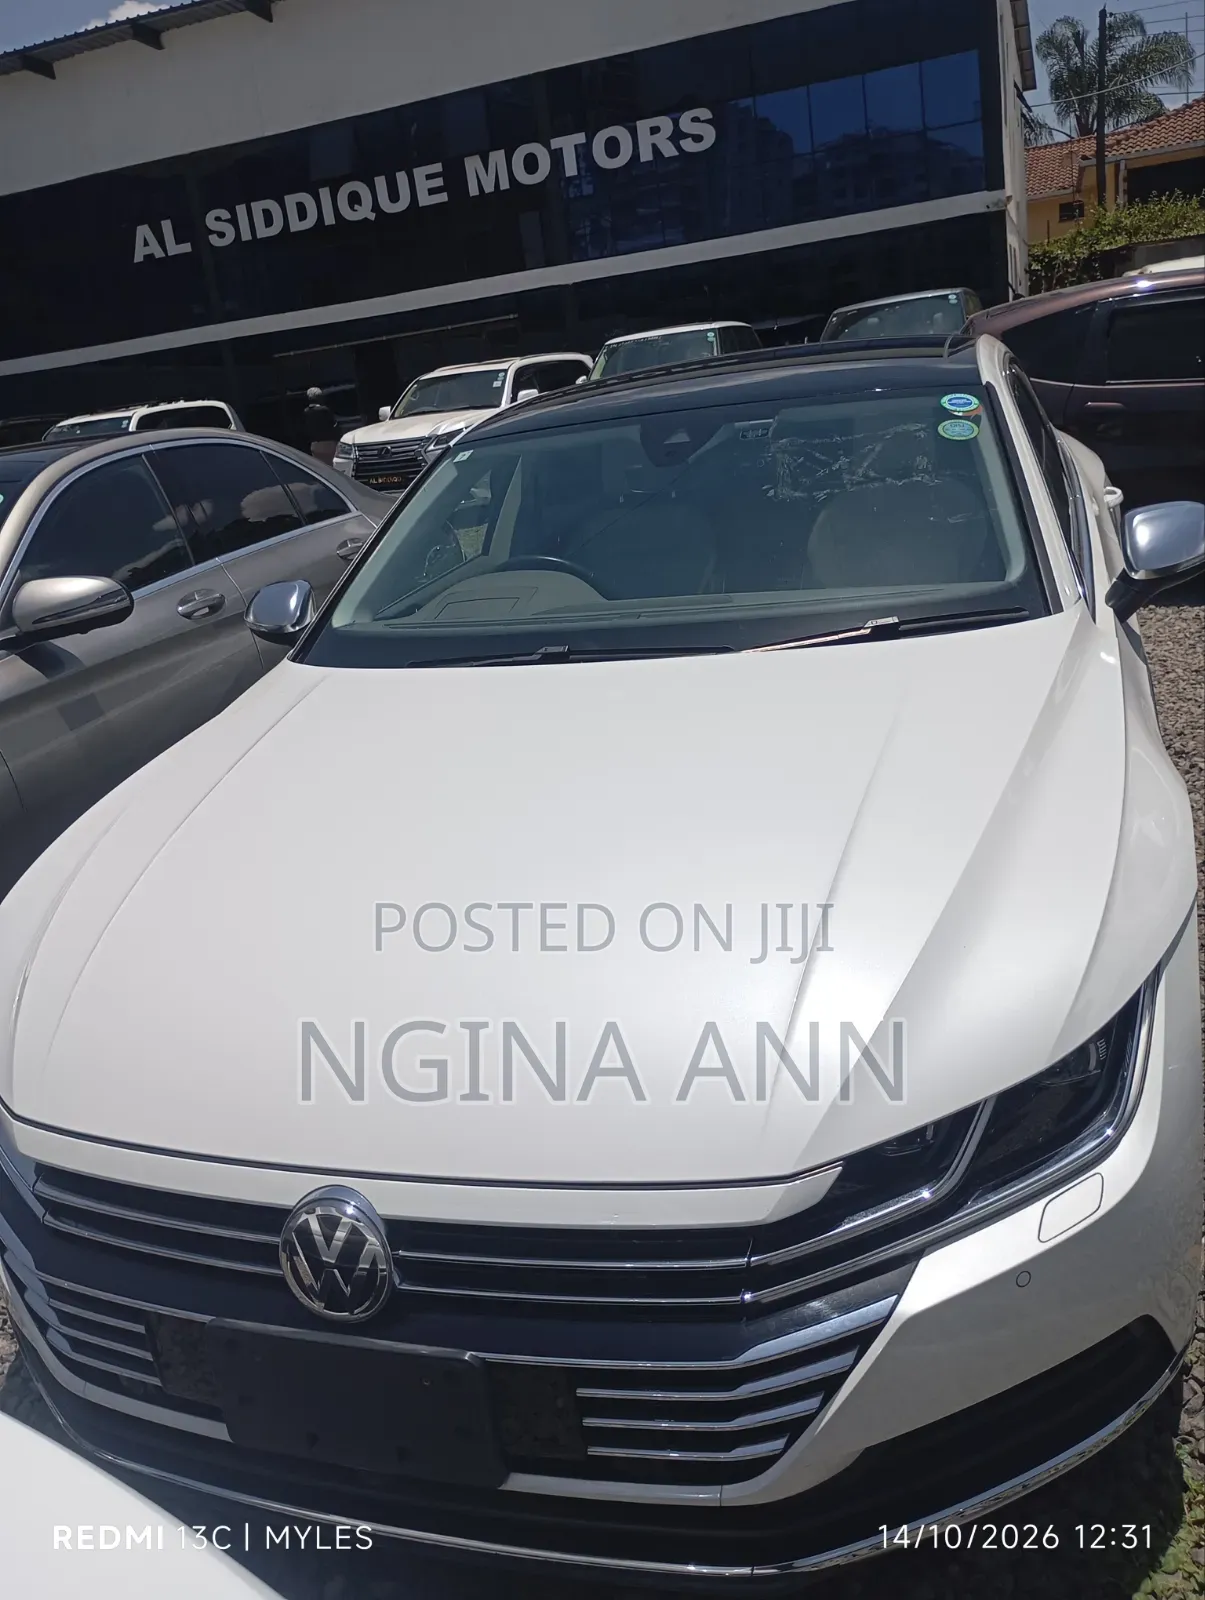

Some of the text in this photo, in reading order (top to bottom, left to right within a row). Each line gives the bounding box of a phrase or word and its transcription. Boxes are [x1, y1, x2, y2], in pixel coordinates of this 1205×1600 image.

[133, 107, 717, 263] AL SIDDIQUE MOTORS
